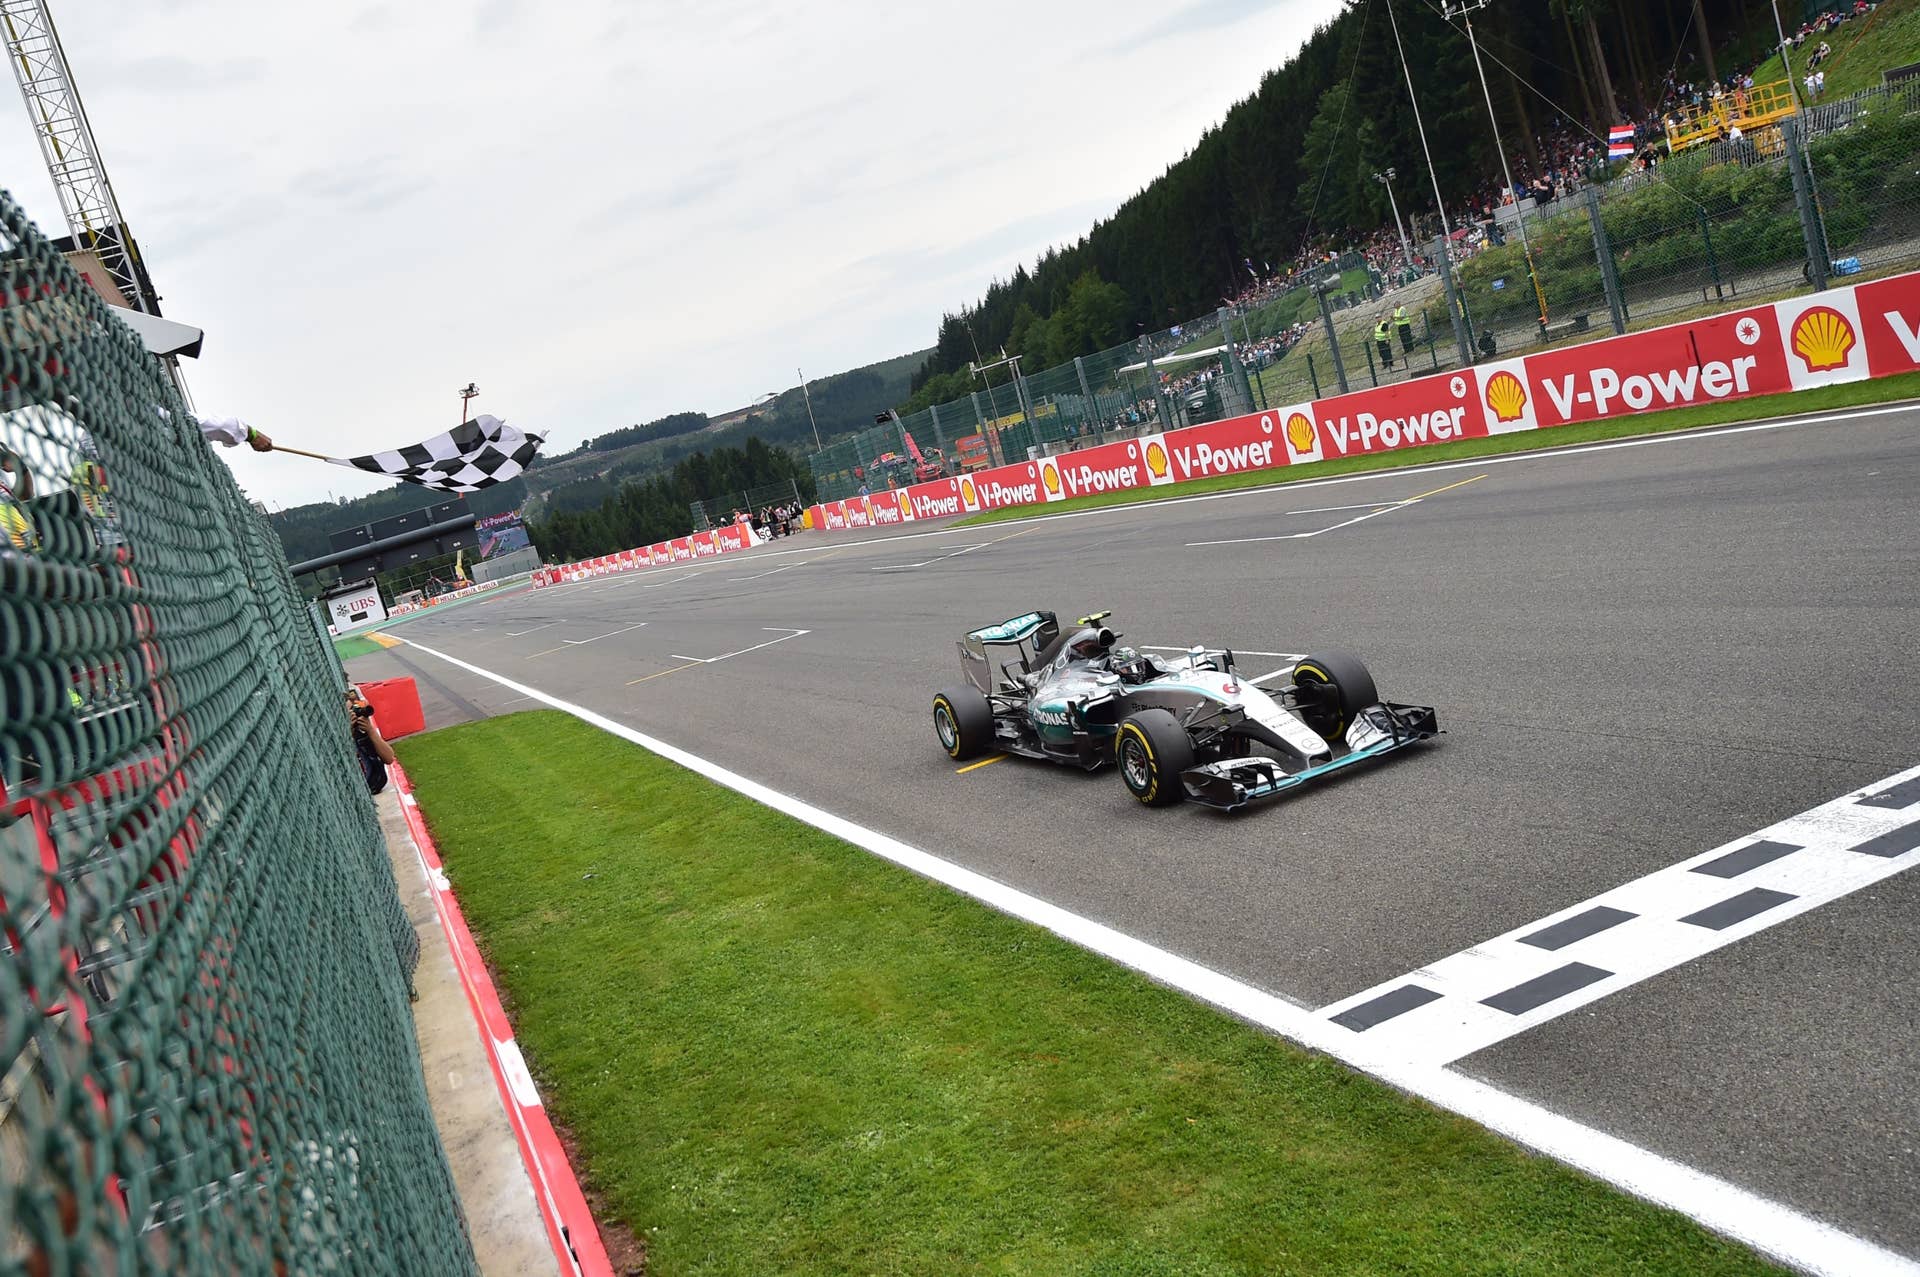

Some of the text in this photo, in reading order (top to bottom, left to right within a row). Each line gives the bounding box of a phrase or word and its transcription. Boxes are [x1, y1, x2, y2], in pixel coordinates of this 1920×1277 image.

[1542, 354, 1756, 420] V-Power
[1325, 406, 1466, 454] V-Power
[1174, 439, 1273, 478] V-Power
[1063, 464, 1138, 495] V-Power
[912, 495, 958, 518] V-Power
[978, 482, 1037, 508] V-Power
[873, 504, 899, 524] V-Power
[350, 596, 376, 612] UBS
